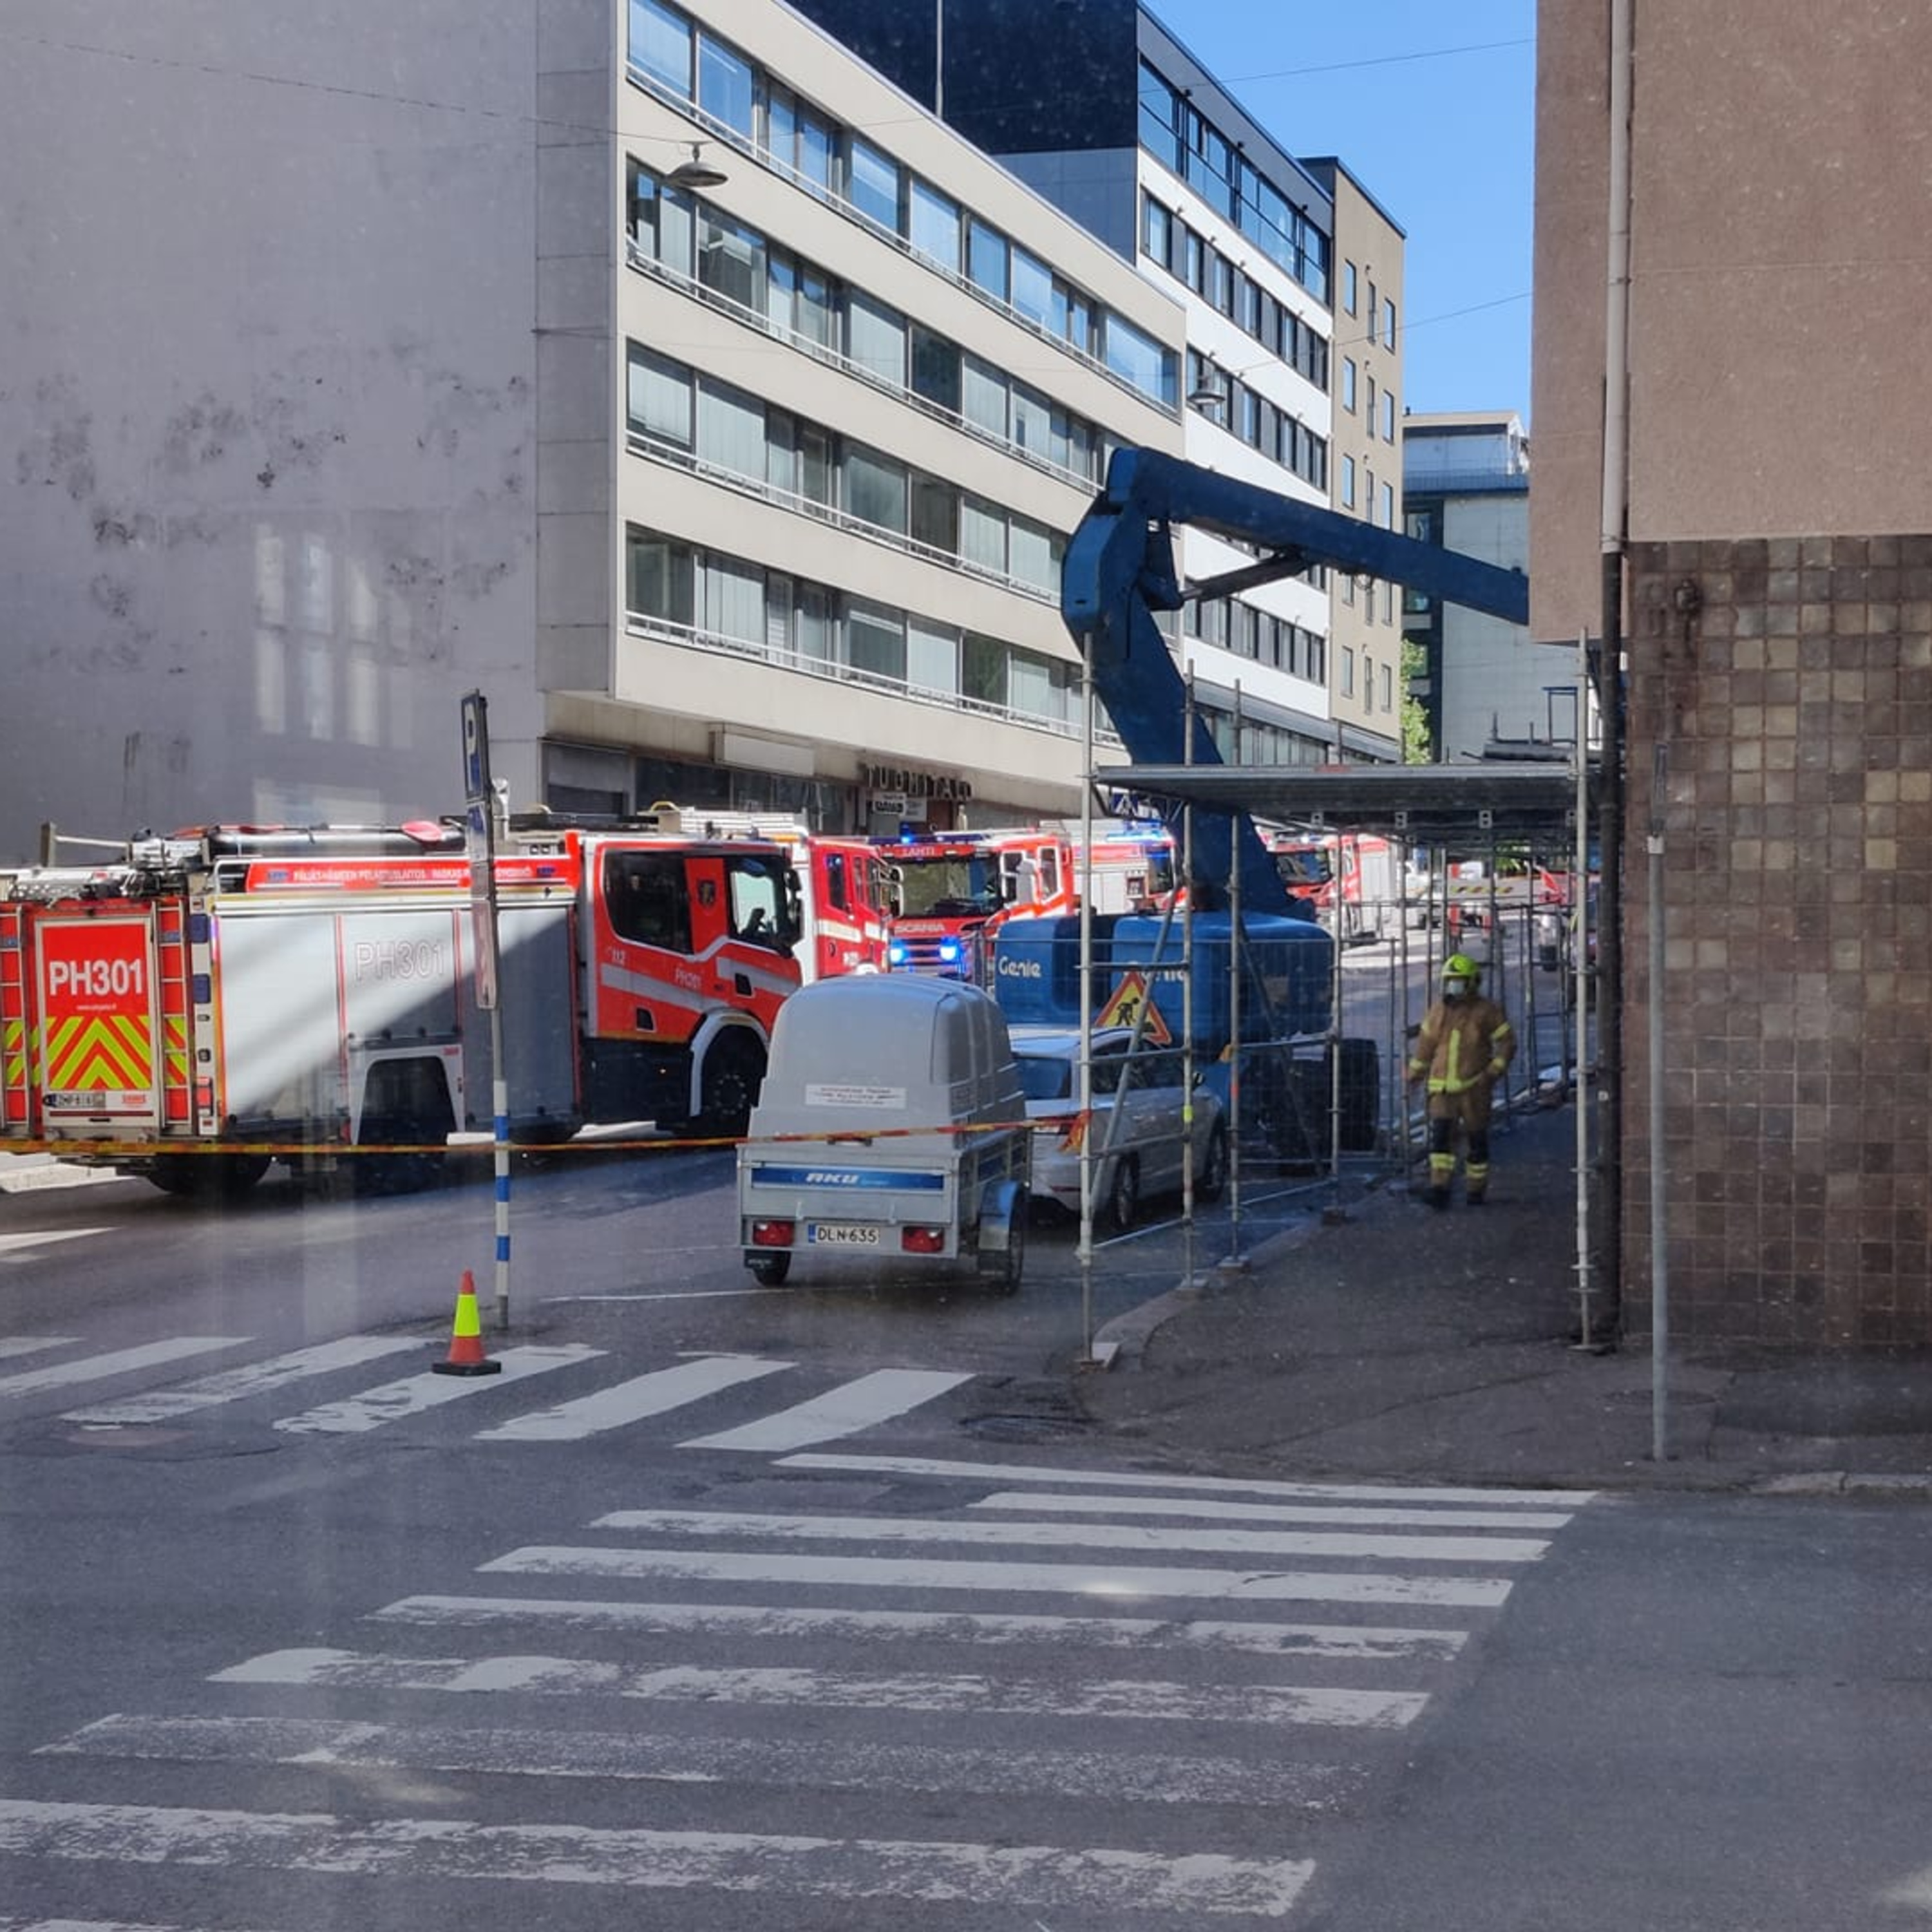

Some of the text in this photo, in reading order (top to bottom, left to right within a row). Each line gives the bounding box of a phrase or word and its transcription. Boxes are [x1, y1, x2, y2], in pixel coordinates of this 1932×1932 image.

[895, 922, 945, 932] SCANIA
[356, 940, 445, 980] PH301
[998, 956, 1042, 978] Genie
[49, 958, 142, 996] PH301
